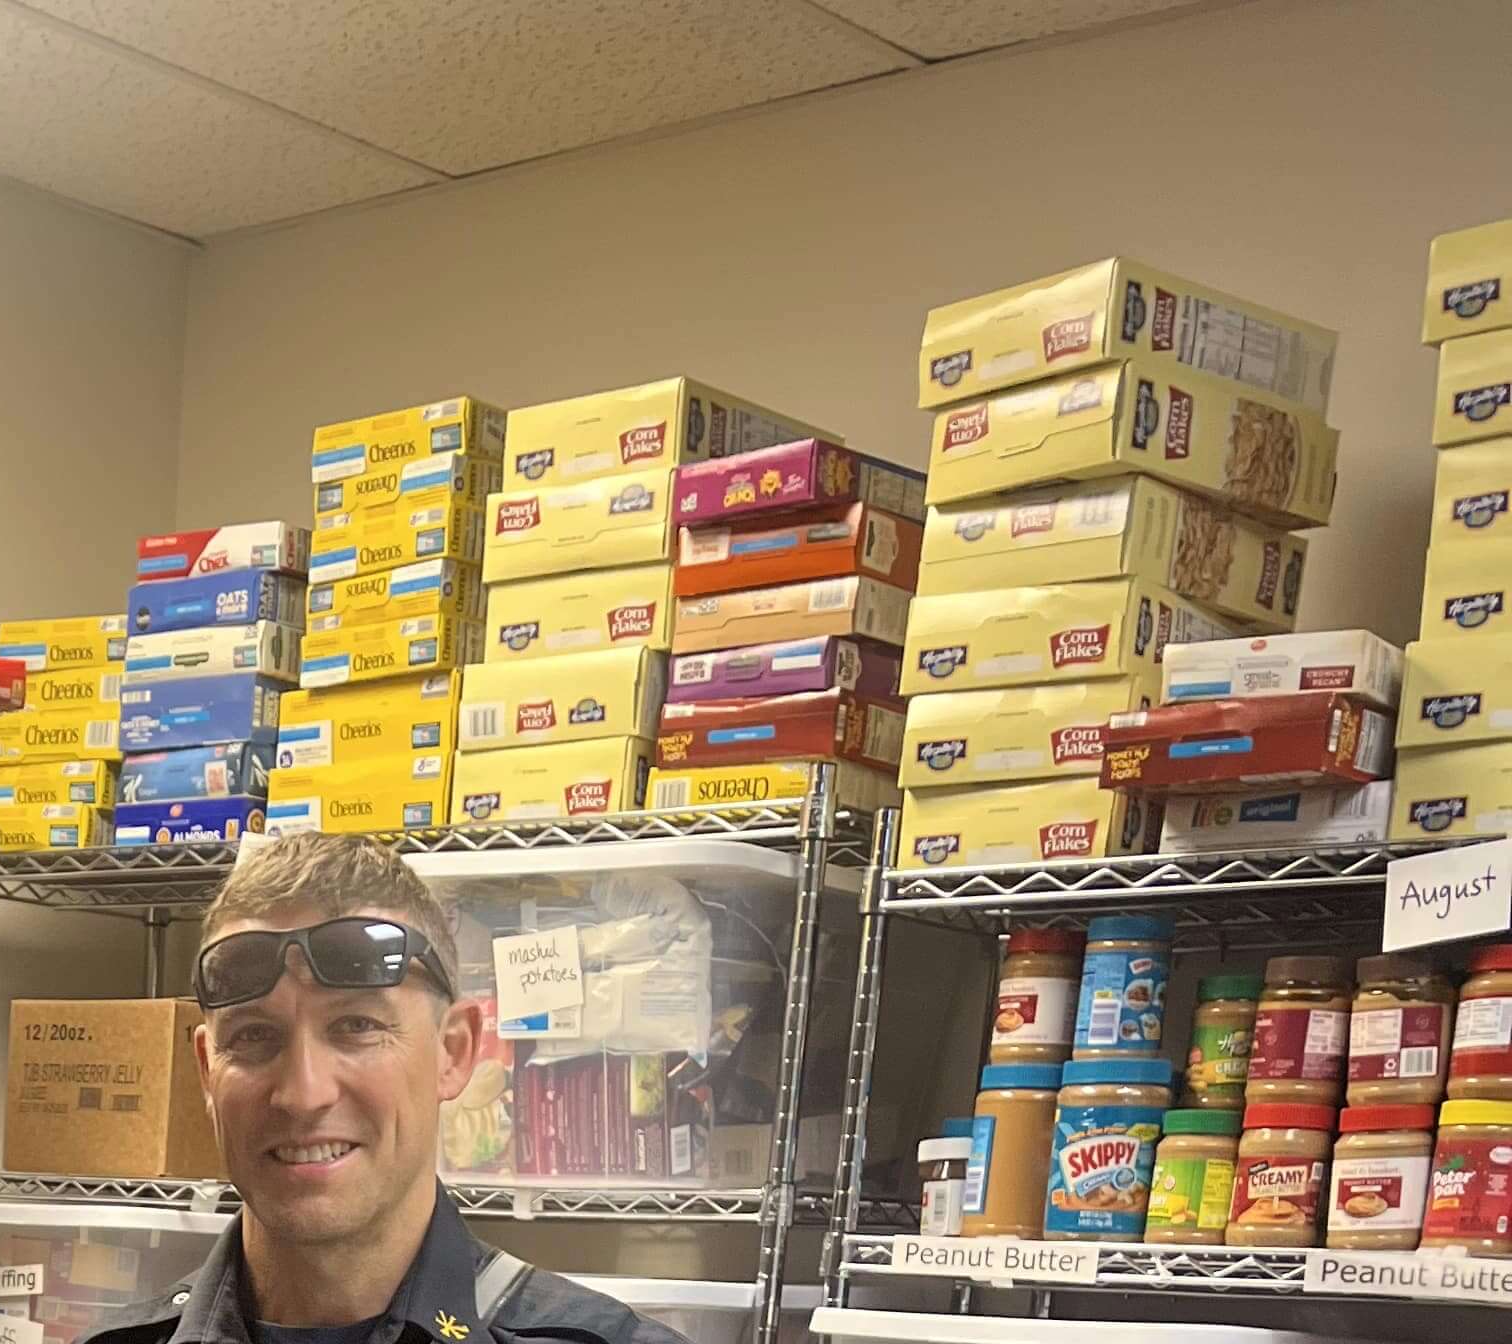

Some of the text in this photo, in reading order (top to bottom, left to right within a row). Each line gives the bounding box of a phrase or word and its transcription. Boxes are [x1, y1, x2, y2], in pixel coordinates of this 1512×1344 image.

[1050, 321, 1085, 337] Corn
[1047, 335, 1088, 356] Flakes
[627, 428, 658, 443] Corn
[369, 440, 416, 463] Cheerios
[623, 440, 662, 459] Flakes
[356, 474, 398, 496] Cheerios
[360, 545, 402, 566] Cheerios
[347, 578, 386, 597] Cheerios
[615, 607, 647, 621] Corn
[612, 618, 650, 636] Flakes
[1059, 631, 1099, 648] Corn
[50, 642, 93, 663] Cheerios
[353, 651, 395, 673] Cheerios
[1055, 645, 1103, 666] Flakes
[41, 680, 93, 702] Cheerios
[25, 724, 78, 746] Cheerios
[341, 720, 383, 741] Cheerios
[1060, 726, 1100, 743] Corn
[1055, 740, 1104, 760] Flakes
[571, 783, 604, 797] Corn
[699, 776, 769, 801] Cheerios
[330, 800, 374, 819] Cheerios
[568, 793, 608, 810] Flakes
[1048, 822, 1087, 840] Corn
[1044, 837, 1090, 856] Flakes
[1400, 864, 1497, 920] August
[509, 935, 560, 965] mashed
[520, 963, 578, 994] potatoes
[24, 1023, 93, 1042] 12/20oz.
[1068, 1142, 1136, 1179] SKIPPY
[1249, 1169, 1306, 1188] CREAMY
[1432, 1169, 1476, 1188] Peter
[905, 1241, 1087, 1276] Peanut Butter
[1320, 1258, 1428, 1291] Peanut
